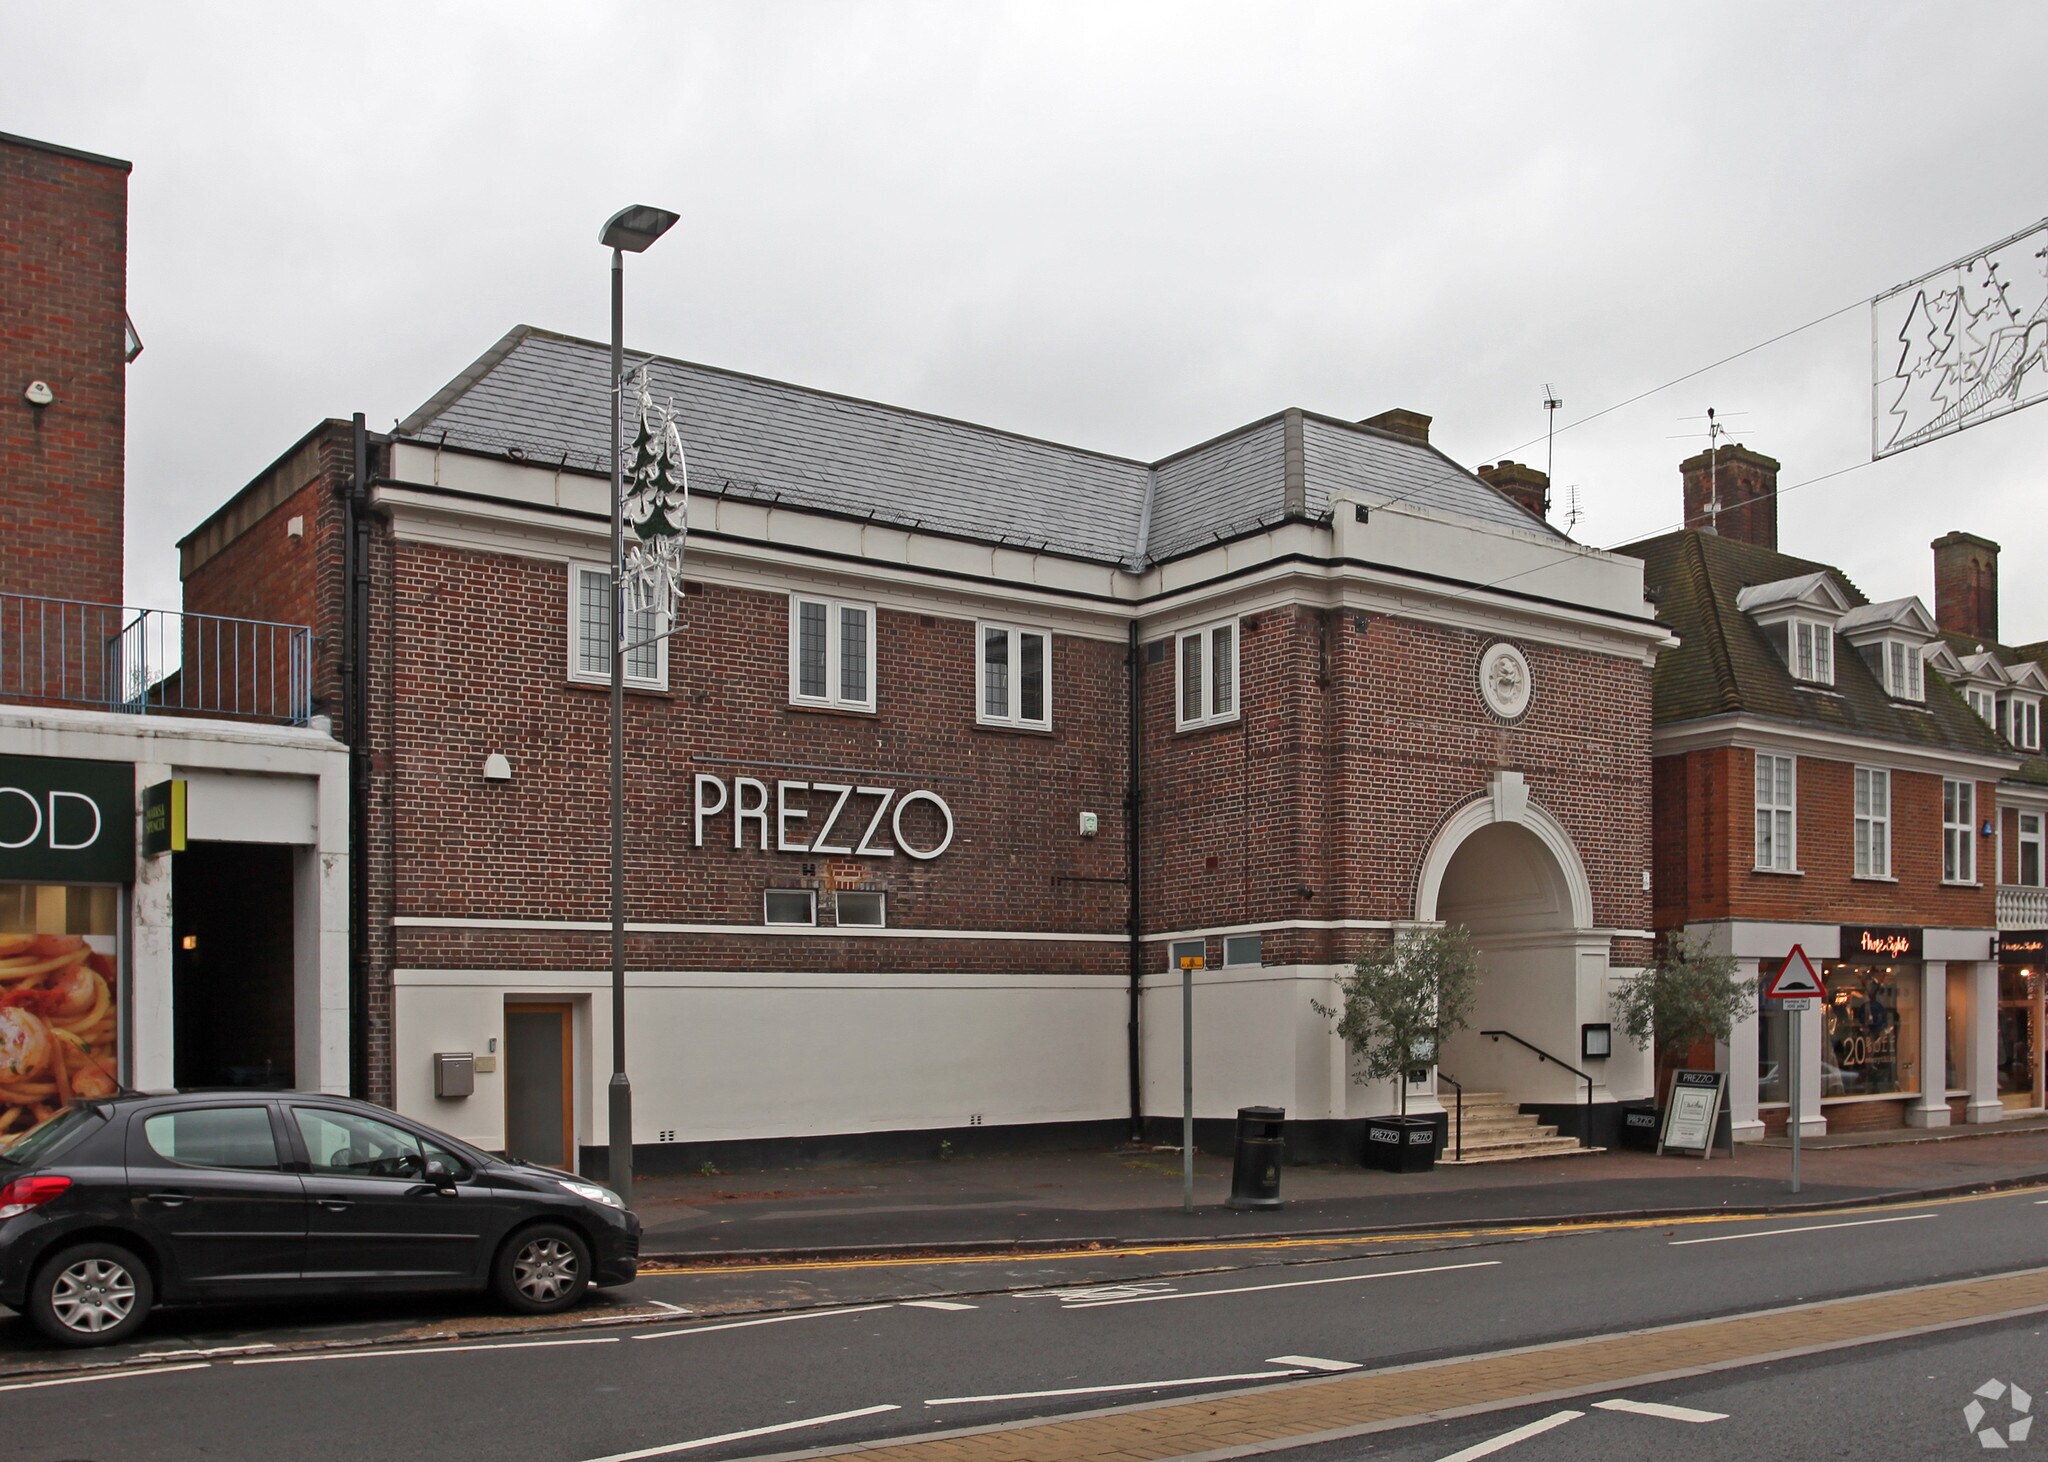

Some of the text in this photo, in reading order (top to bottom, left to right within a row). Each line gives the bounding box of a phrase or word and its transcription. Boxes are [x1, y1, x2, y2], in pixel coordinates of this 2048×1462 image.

[694, 773, 954, 860] PREZZO
[1683, 1073, 1714, 1083] PREZZO
[1370, 1128, 1399, 1143] PREZZO
[1410, 1131, 1433, 1144] PREZZO
